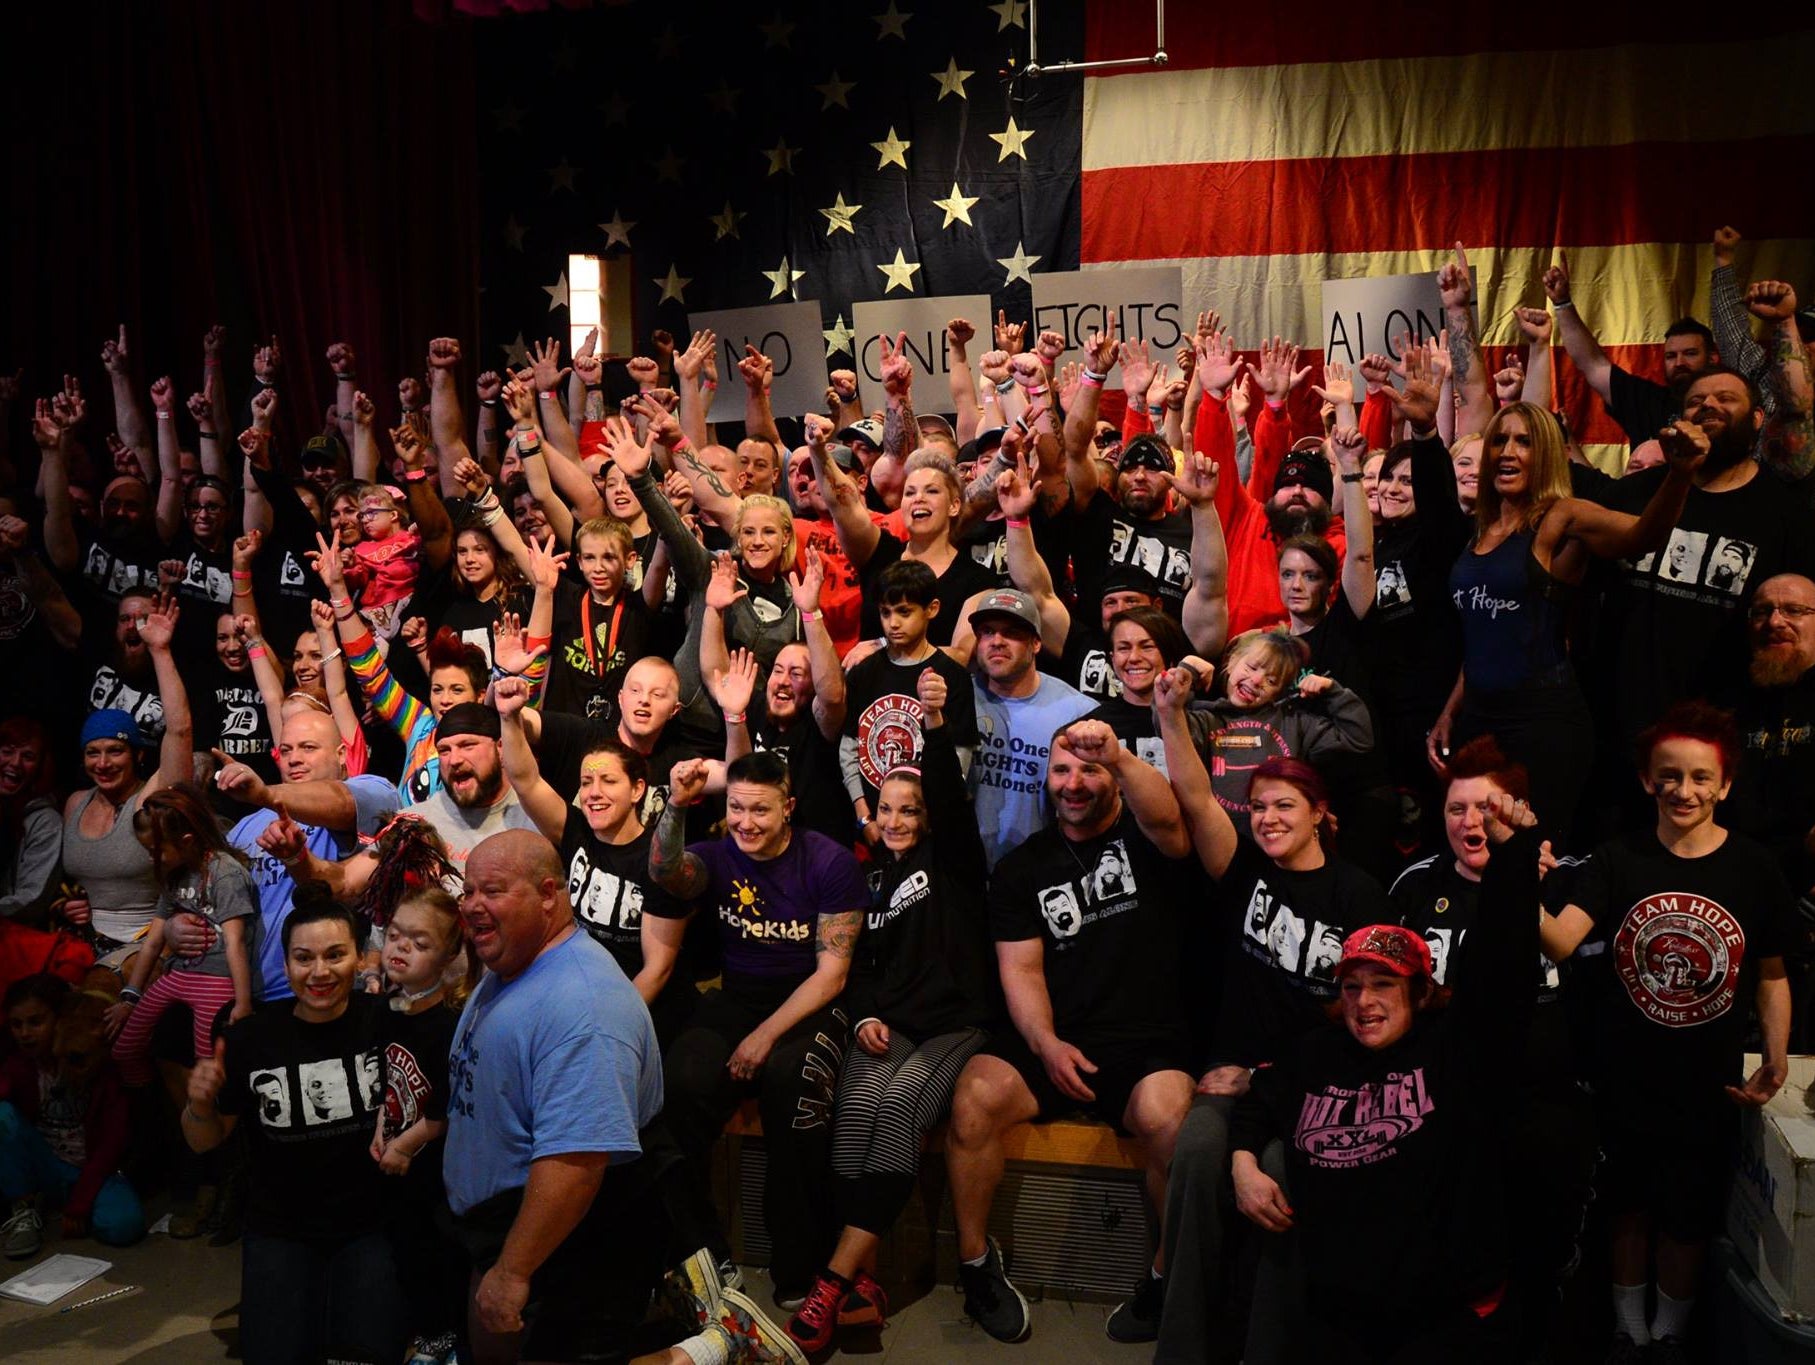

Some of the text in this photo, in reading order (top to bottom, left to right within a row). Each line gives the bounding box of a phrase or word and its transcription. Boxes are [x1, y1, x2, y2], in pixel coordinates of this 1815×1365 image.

[1035, 303, 1181, 350] FIGHTS
[1469, 584, 1520, 620] Hope
[860, 698, 894, 729] TEAM
[979, 732, 1049, 758] No One
[860, 756, 876, 777] LIFT
[972, 751, 1039, 776] IGHTS
[1625, 897, 1679, 933] TEAM
[1688, 899, 1742, 948] HOPE
[1621, 966, 1641, 993] LIFT
[1647, 1002, 1689, 1022] RAISE
[1700, 986, 1735, 1016] HOPE
[395, 1051, 429, 1100] HOPE
